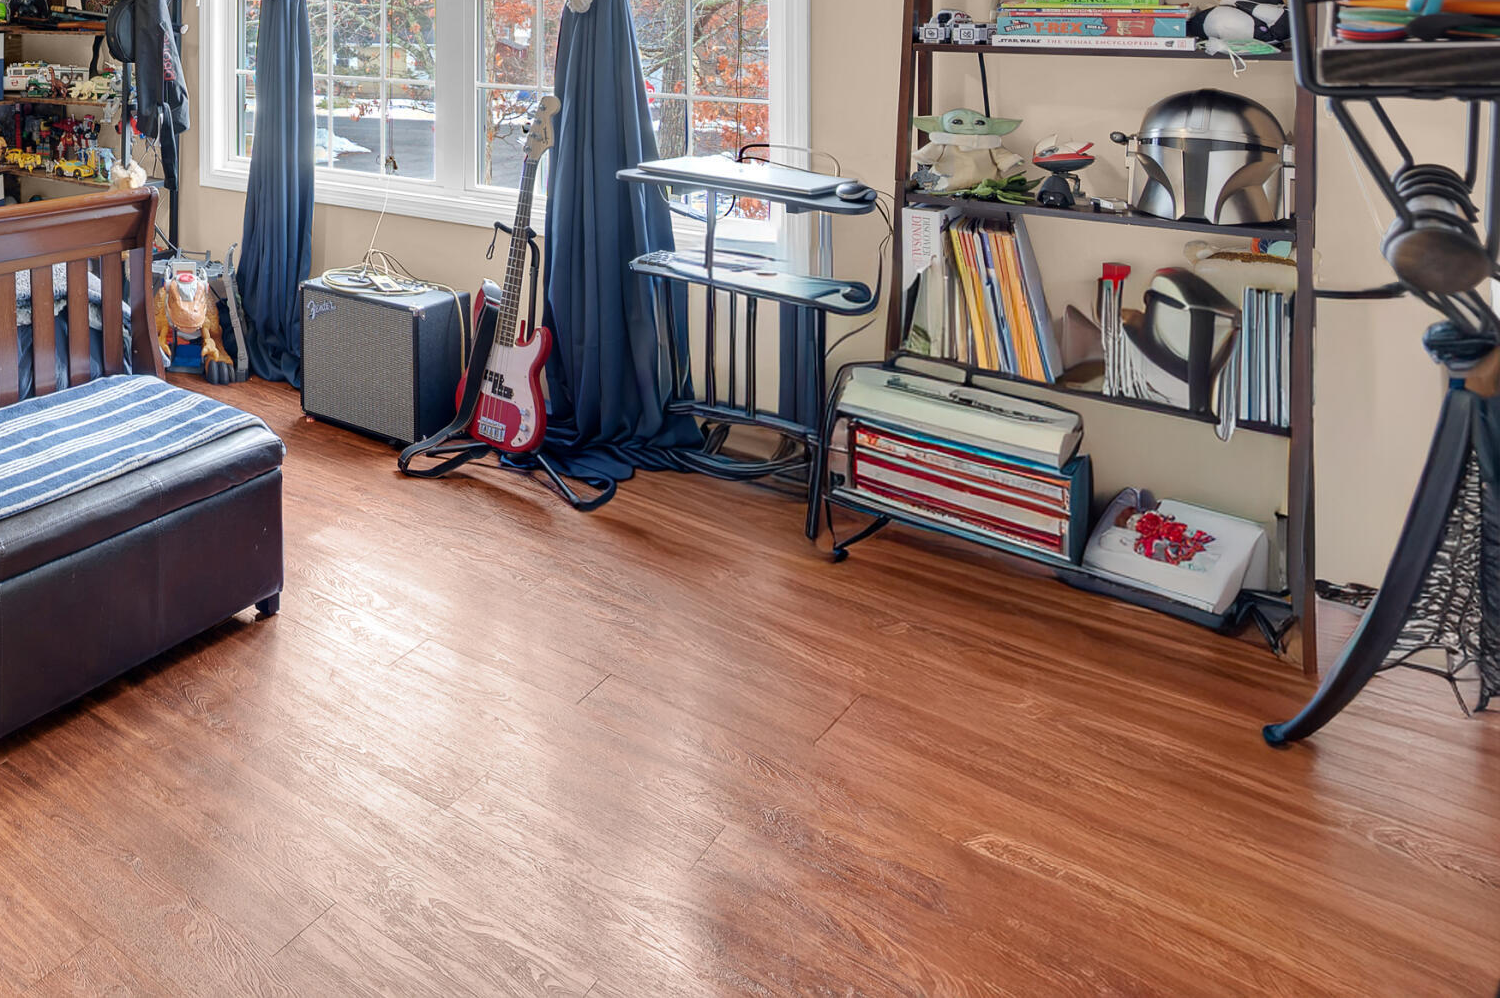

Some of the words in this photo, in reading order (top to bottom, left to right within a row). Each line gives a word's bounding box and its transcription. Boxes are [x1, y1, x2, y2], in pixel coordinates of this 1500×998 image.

[1032, 21, 1084, 35] T-REX
[1095, 39, 1159, 47] ENCYCLOPEDIA
[307, 300, 337, 320] Fender
